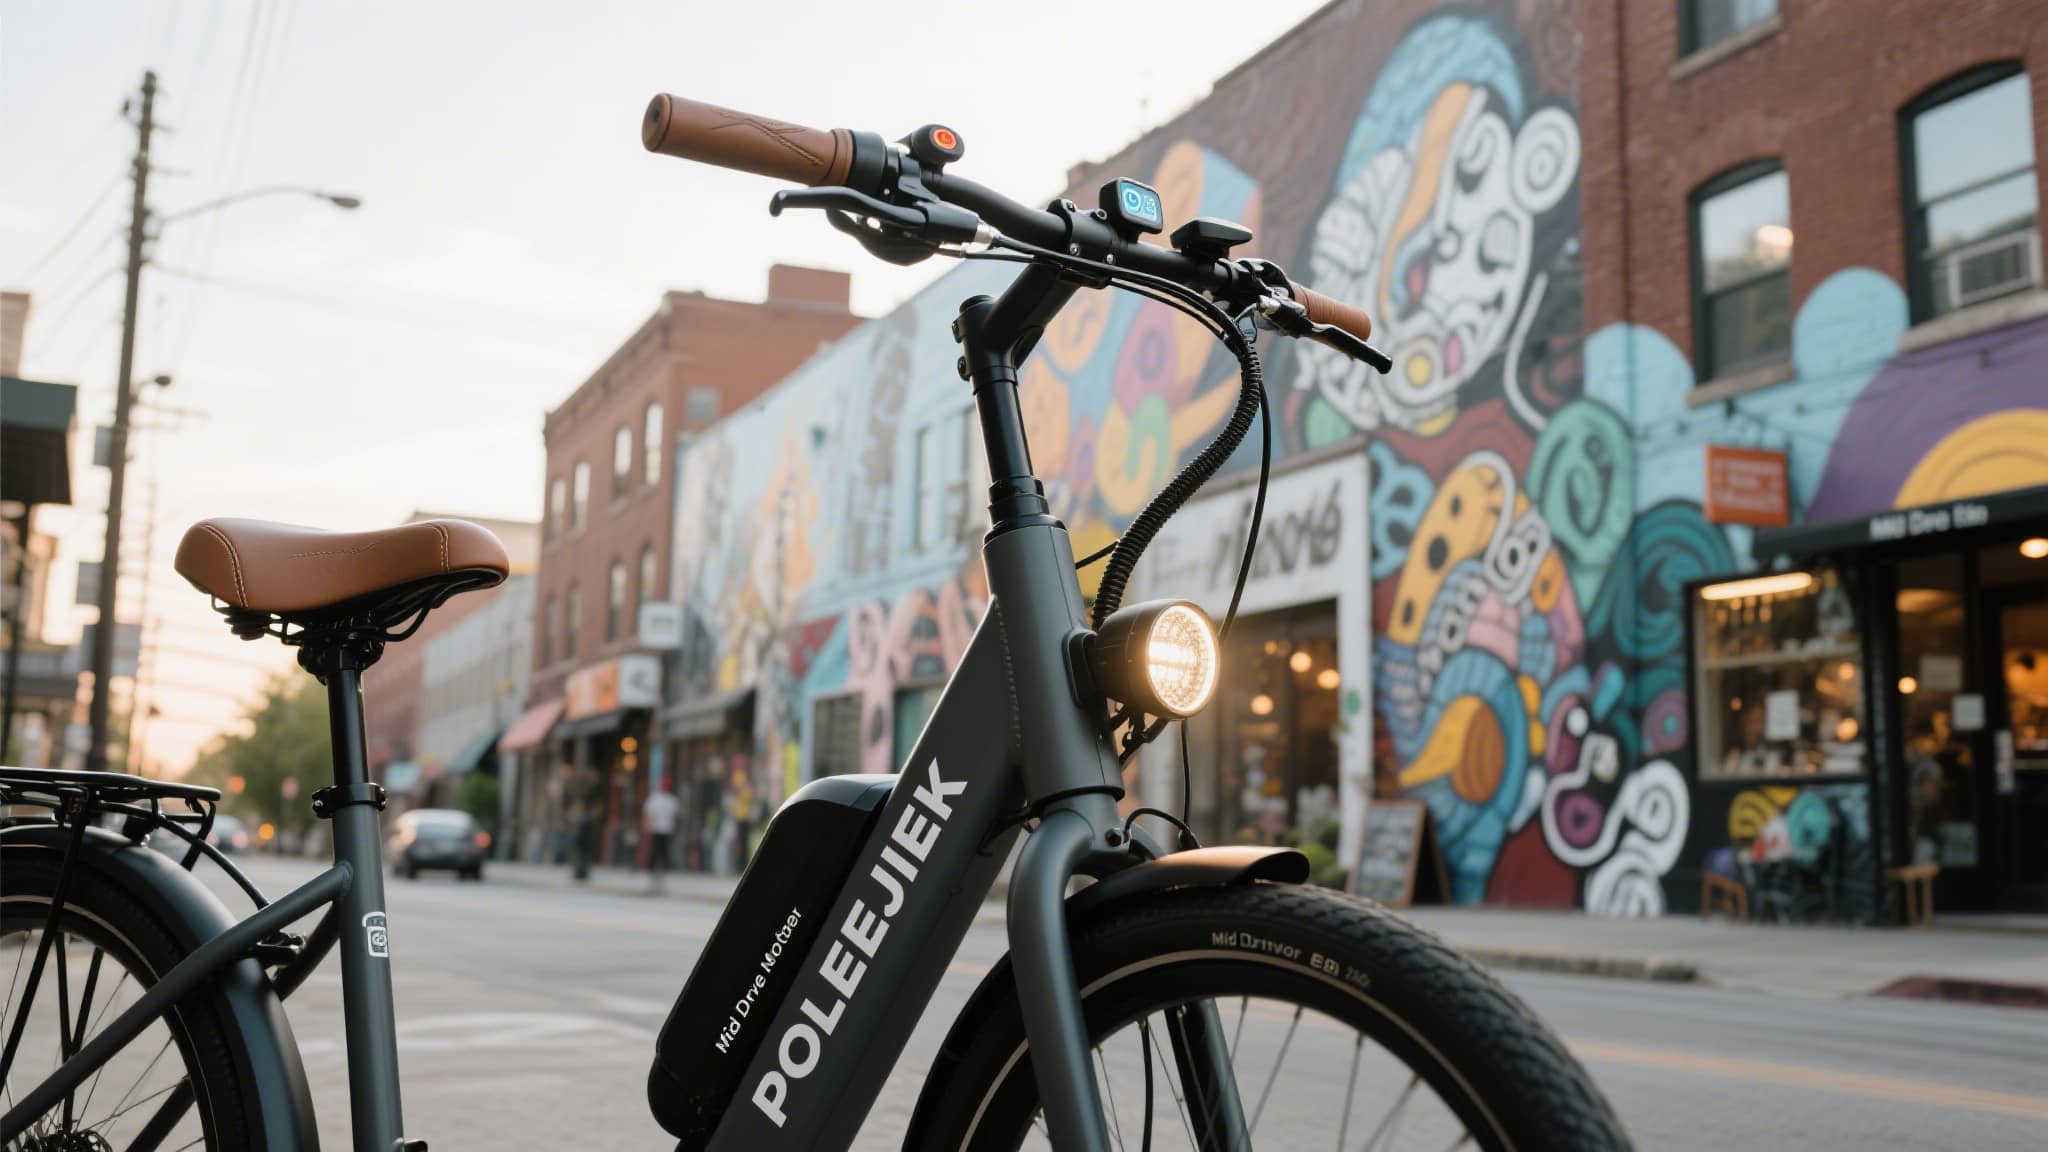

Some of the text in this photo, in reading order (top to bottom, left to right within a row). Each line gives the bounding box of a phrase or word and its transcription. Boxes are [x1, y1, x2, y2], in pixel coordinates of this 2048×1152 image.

[751, 758, 967, 1128] POLEEJIEK
[1211, 931, 1237, 946] Mid
[715, 1015, 741, 1055] Mid
